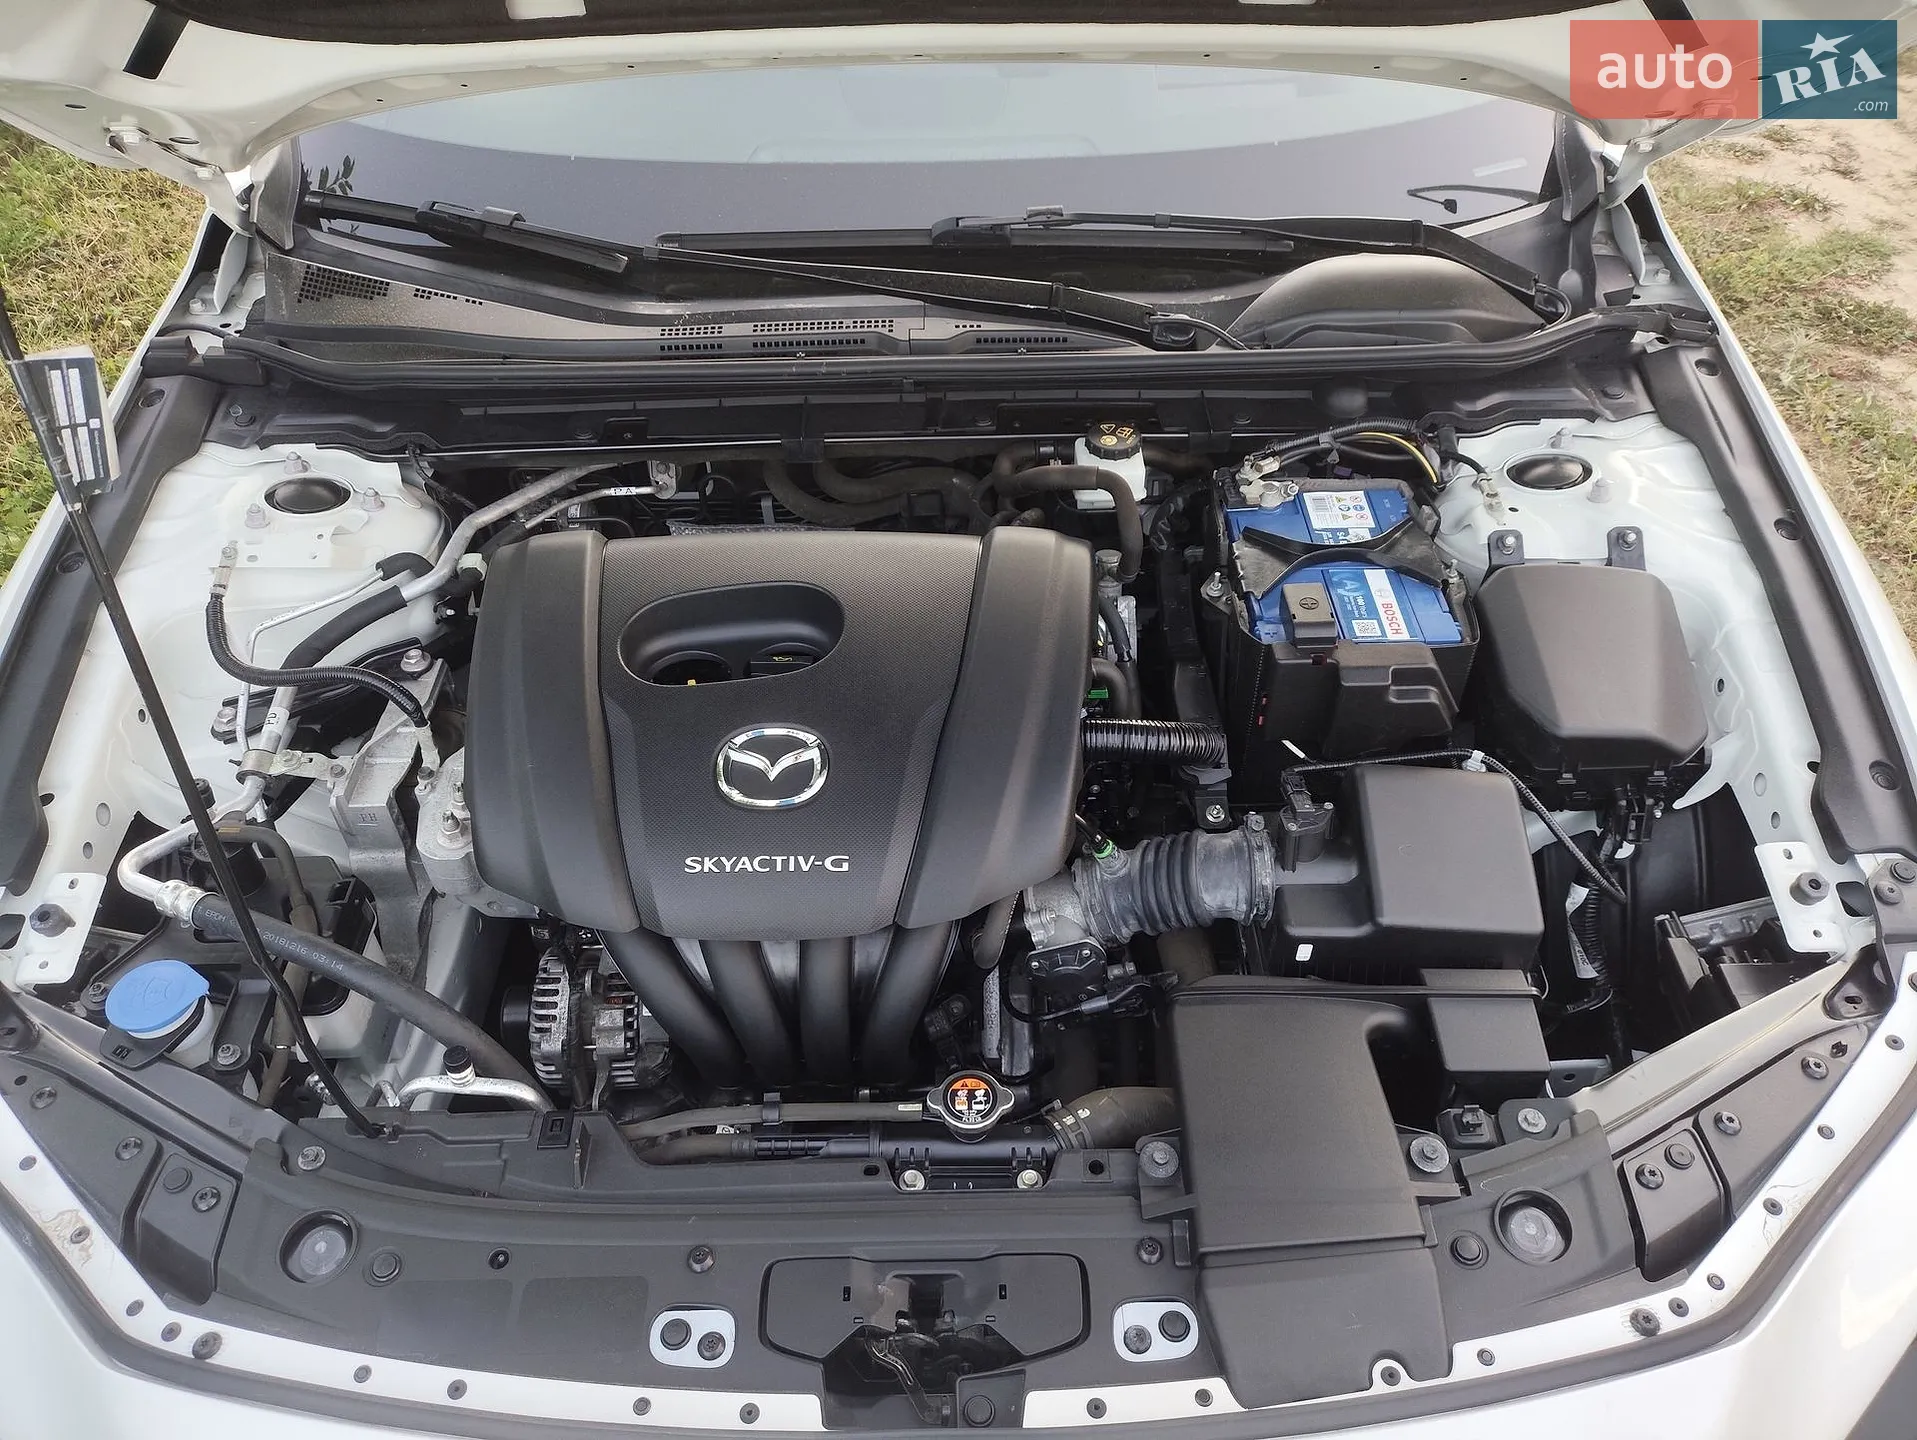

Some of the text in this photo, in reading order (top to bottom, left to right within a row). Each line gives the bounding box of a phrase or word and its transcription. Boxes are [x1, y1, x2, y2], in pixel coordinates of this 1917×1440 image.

[1381, 602, 1404, 635] BOSCH
[684, 854, 850, 874] SKYACTIV-G
[263, 931, 309, 955] 20181216
